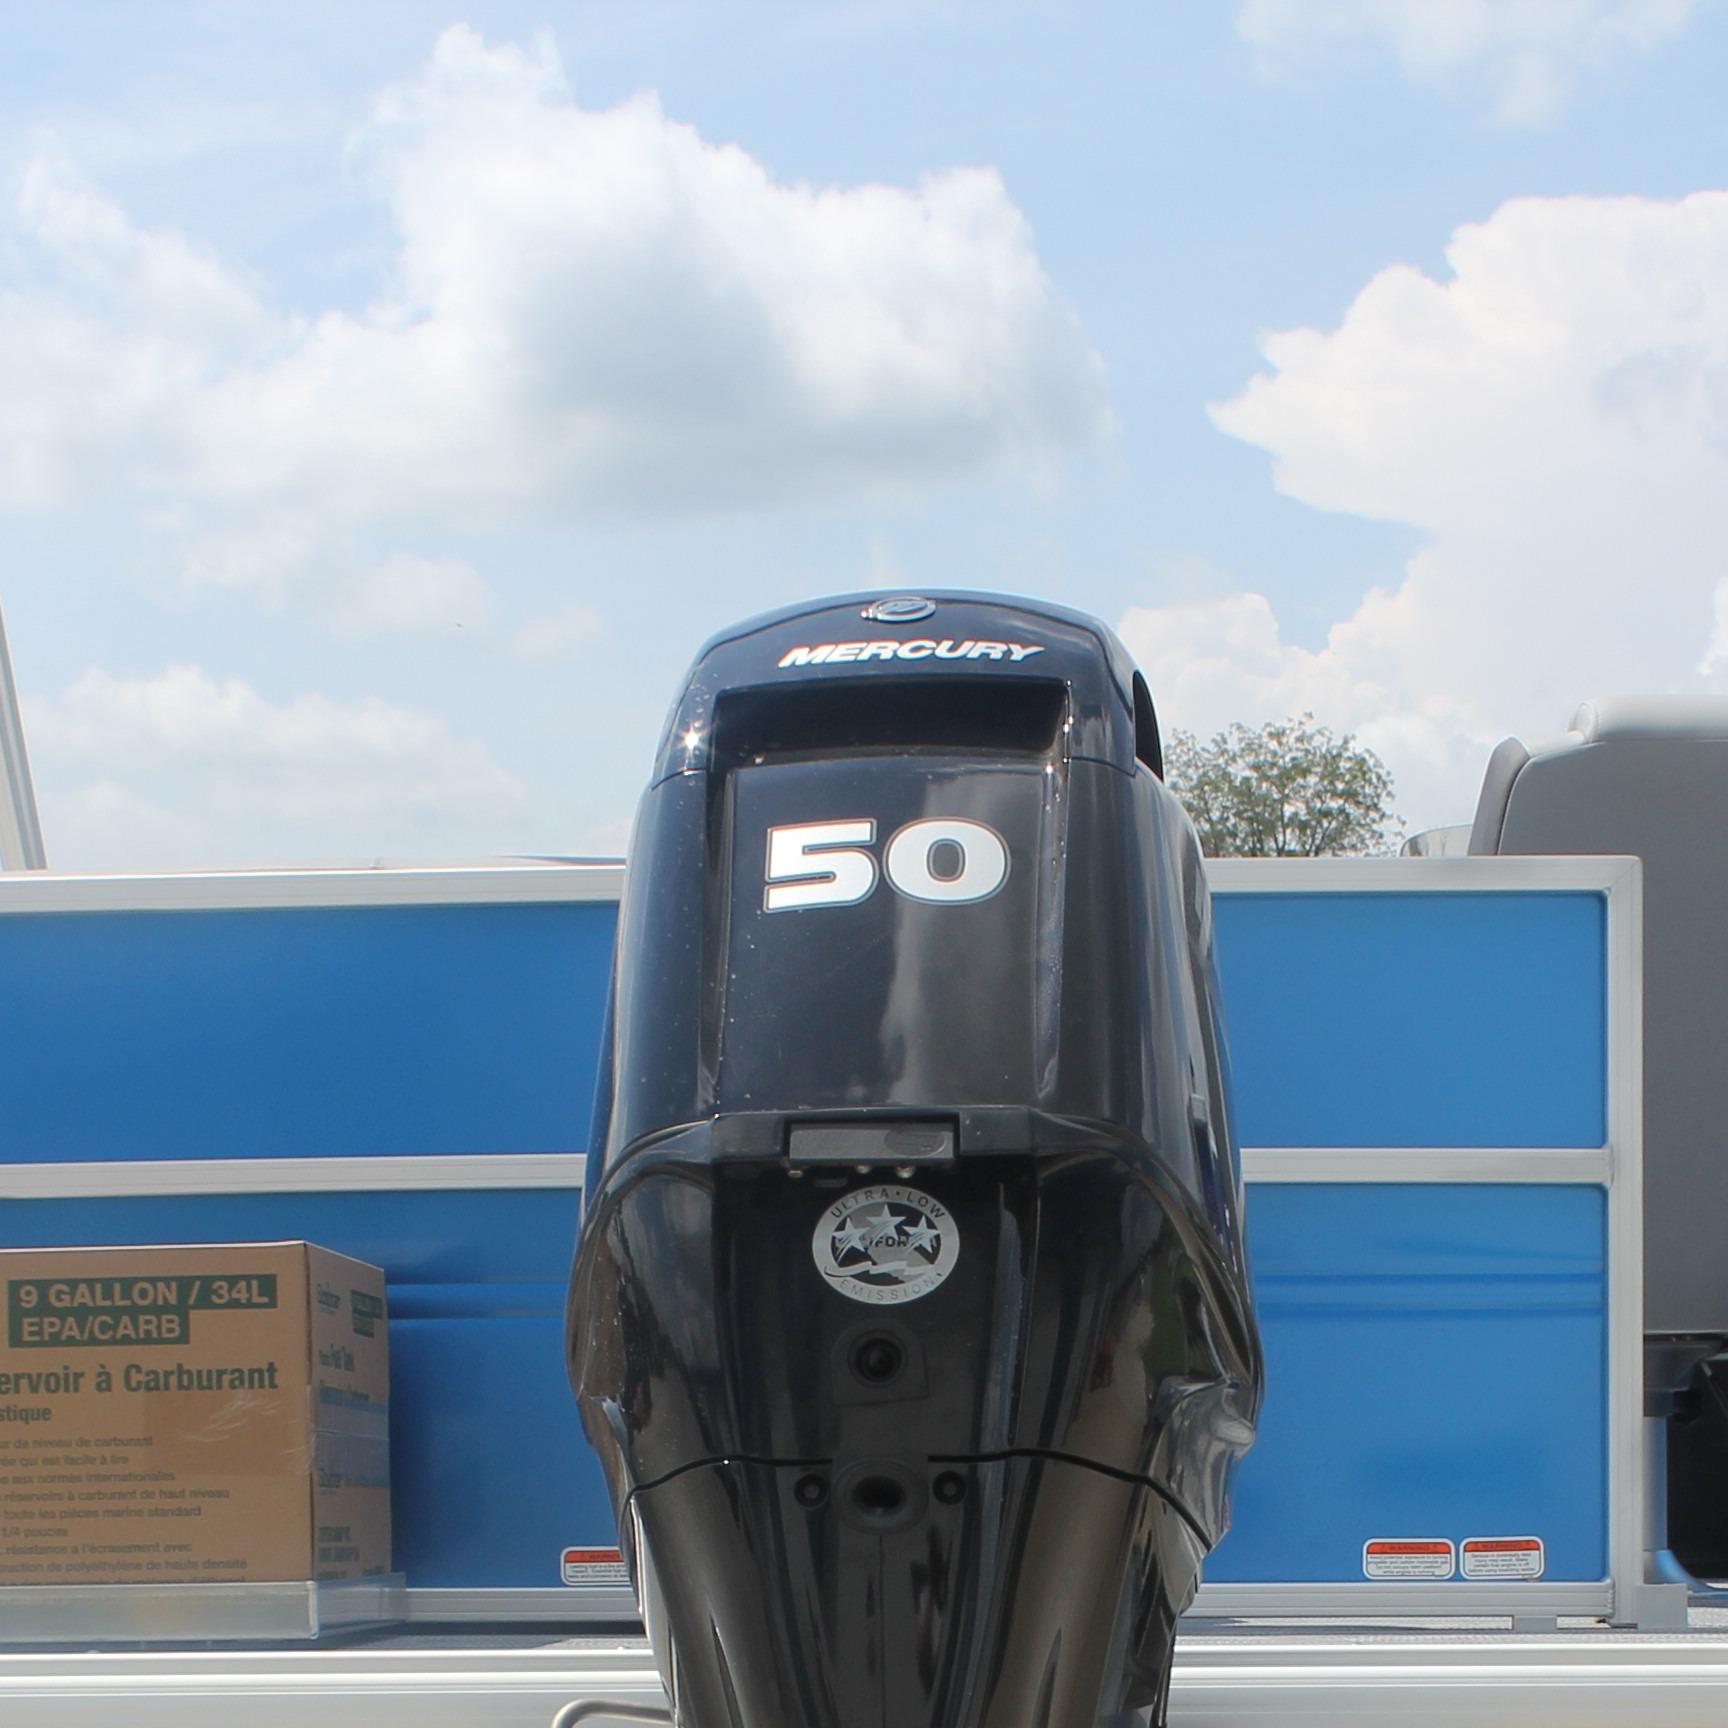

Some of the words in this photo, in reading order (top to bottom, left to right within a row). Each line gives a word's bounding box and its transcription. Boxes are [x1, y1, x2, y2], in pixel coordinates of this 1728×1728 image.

[778, 639, 1045, 668] MERCURY
[761, 817, 1014, 914] 50
[830, 1187, 889, 1220] ULTRA
[905, 1191, 945, 1220] LOW
[18, 1285, 38, 1308] 9
[48, 1282, 177, 1308] GALLON
[188, 1280, 202, 1305] /
[210, 1279, 269, 1304] 34L
[839, 1277, 936, 1301] EMISSION
[22, 1314, 181, 1342] EPA/CARB
[95, 1364, 112, 1392] à
[124, 1361, 278, 1392] Carburant
